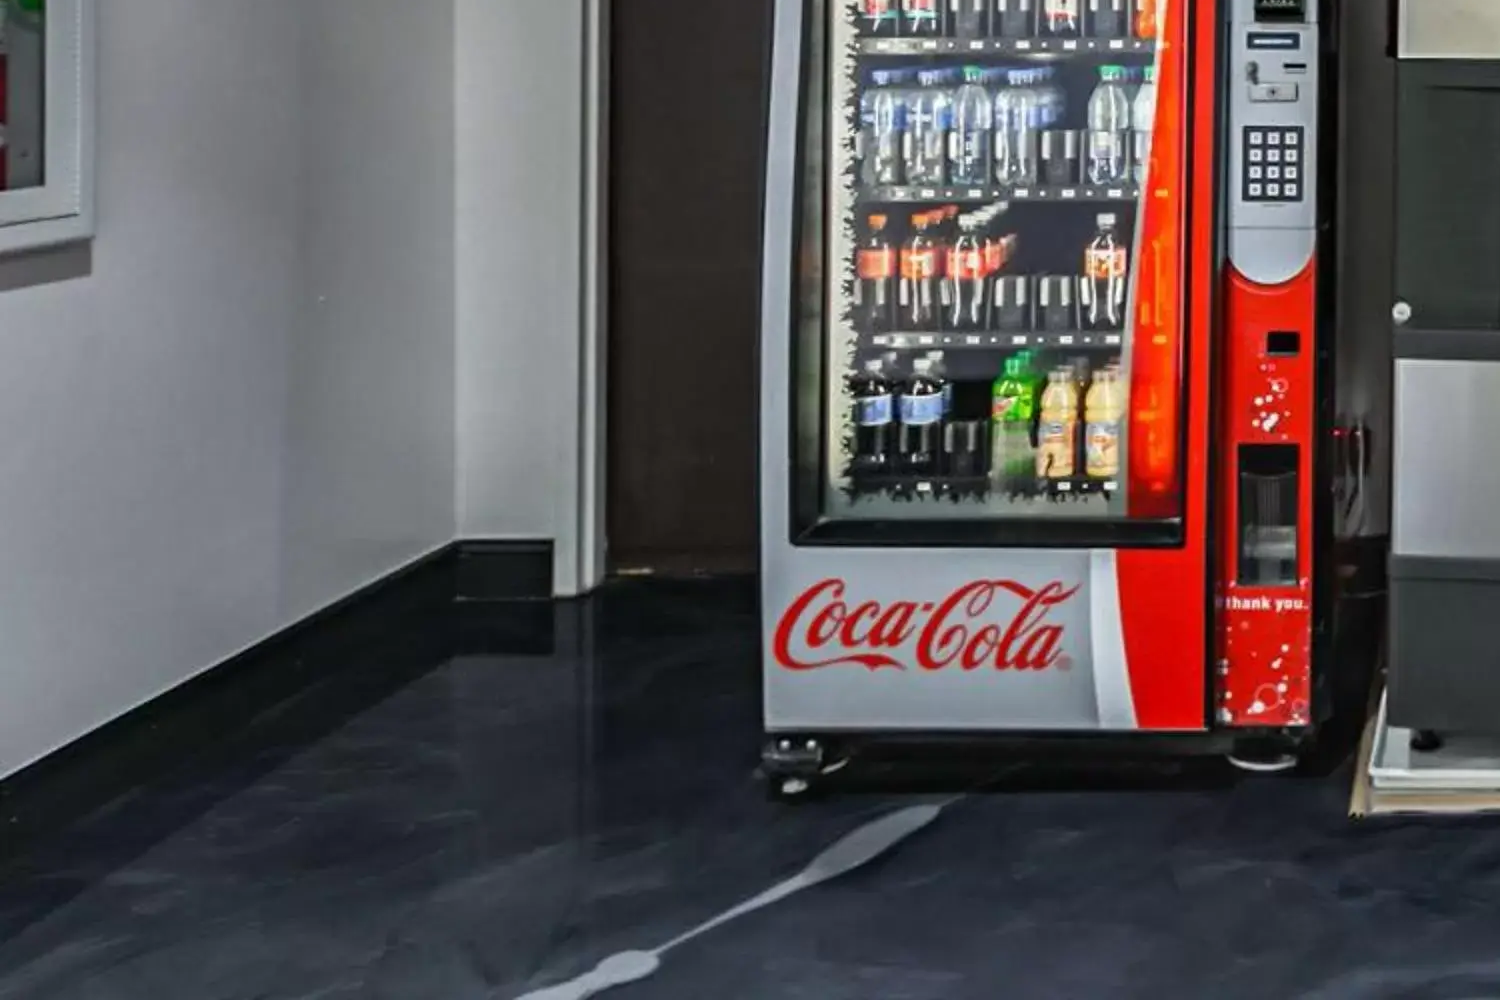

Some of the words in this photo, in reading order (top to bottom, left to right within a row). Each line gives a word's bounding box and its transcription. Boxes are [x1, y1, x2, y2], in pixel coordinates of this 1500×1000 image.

[773, 578, 1083, 671] Coca-Cola
[1225, 595, 1271, 611] thank
[1275, 598, 1309, 613] you.
